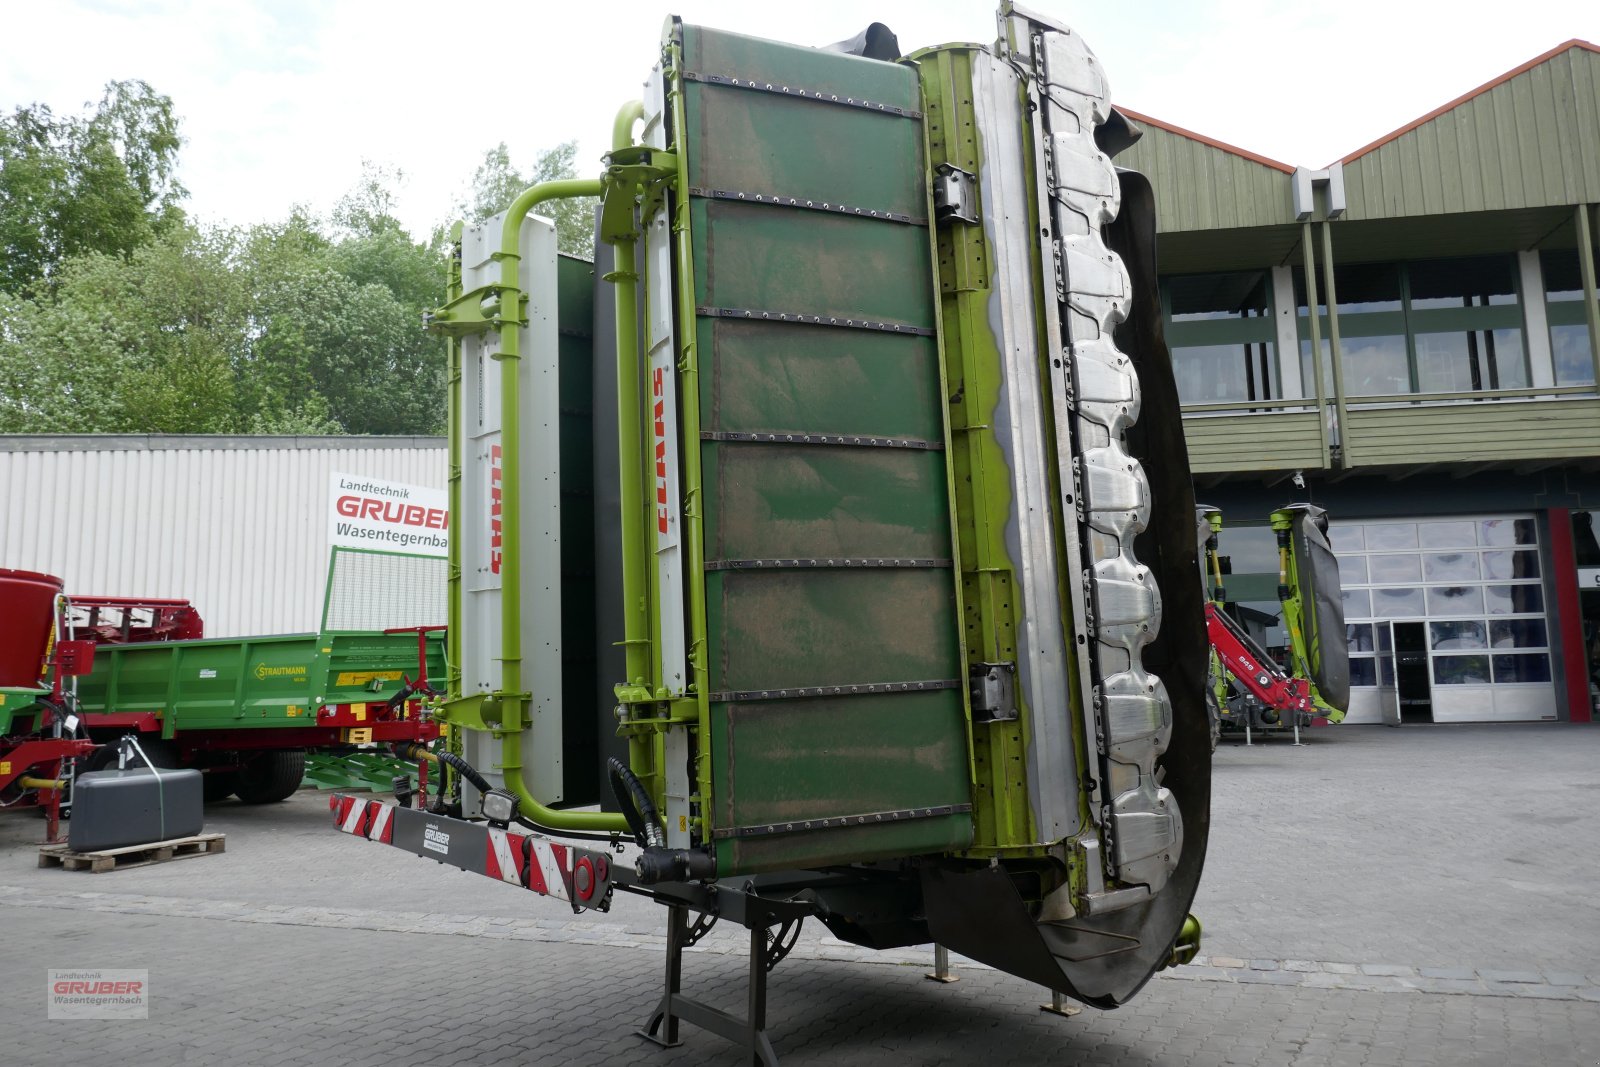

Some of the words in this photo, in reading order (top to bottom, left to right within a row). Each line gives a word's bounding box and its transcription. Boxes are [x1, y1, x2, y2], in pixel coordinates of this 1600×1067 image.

[653, 367, 668, 535] CLAAS
[340, 478, 410, 499] Landtechnik
[259, 666, 306, 677] STRAUTMANN
[425, 828, 450, 846] GRUBER
